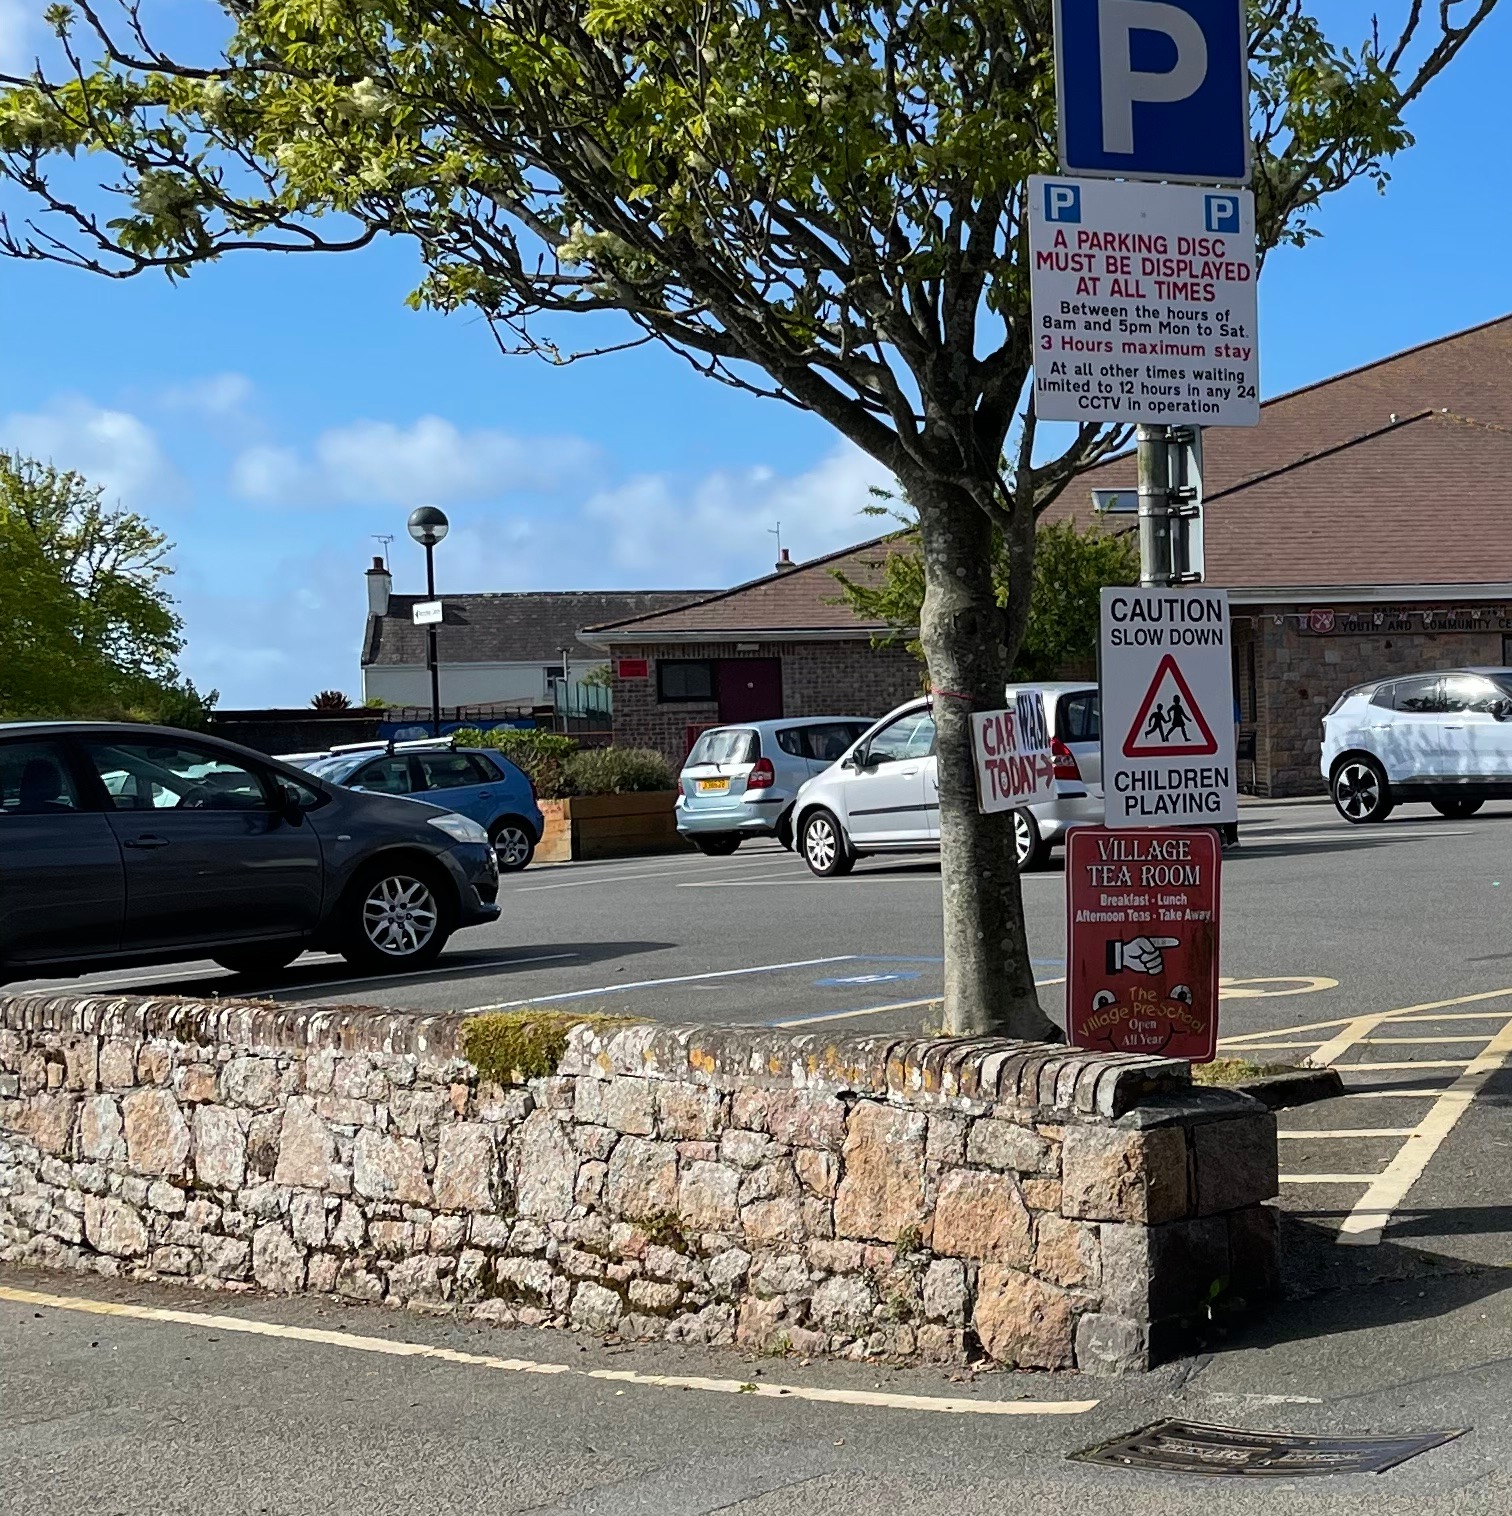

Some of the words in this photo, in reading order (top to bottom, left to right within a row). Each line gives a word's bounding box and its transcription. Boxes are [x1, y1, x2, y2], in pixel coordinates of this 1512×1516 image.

[1098, 0, 1208, 154] P
[1050, 186, 1075, 220] P
[1210, 198, 1234, 230] P
[1054, 229, 1068, 250] A
[1077, 230, 1168, 256] PARKING
[1177, 236, 1226, 258] DISC
[1036, 251, 1096, 272] MUST
[1105, 256, 1132, 276] BE
[1142, 257, 1250, 282] DISPLAYED
[1076, 276, 1100, 296] AT
[1110, 278, 1146, 298] ALL
[1154, 280, 1216, 302] TIMES
[1060, 301, 1128, 318] Between
[1135, 305, 1160, 319] the
[1167, 306, 1208, 322] hours
[1216, 309, 1230, 322] of
[1042, 316, 1076, 330] 8am
[1084, 318, 1112, 332] and
[1119, 320, 1152, 336] 5pm
[1159, 322, 1190, 336] Mon
[1197, 323, 1213, 337] to
[1040, 334, 1052, 350] 3
[1061, 336, 1113, 354] Hours
[1122, 340, 1206, 358] maximum
[1214, 344, 1252, 361] stay
[1050, 362, 1068, 376] At
[1074, 362, 1094, 377] all
[1100, 364, 1140, 379] other
[1146, 366, 1186, 380] times
[1192, 368, 1244, 384] waiting
[1038, 378, 1090, 393] limited
[1098, 380, 1112, 394] to
[1119, 381, 1134, 395] 12
[1141, 382, 1181, 397] hours
[1188, 384, 1200, 397] in
[1206, 386, 1231, 400] any
[1237, 385, 1256, 398] 24
[1078, 396, 1121, 410] CCTV
[1128, 397, 1142, 411] in
[1148, 399, 1220, 414] operation
[1110, 598, 1222, 622] CAUTION
[1388, 620, 1412, 632] AND
[1422, 617, 1491, 631] COMMUNITY
[1111, 628, 1164, 646] SLOW
[1170, 628, 1223, 646] DOWN
[983, 712, 1016, 756] CAR
[985, 754, 1036, 800] TODAY
[1114, 767, 1228, 792] CHILDREN
[1125, 792, 1220, 816] PLAYING
[1098, 837, 1192, 861] VILLAGE
[1086, 865, 1132, 886] TEA
[1141, 864, 1200, 887] ROOM
[1100, 893, 1150, 906] Breakfast
[1158, 892, 1188, 906] Lunch
[1076, 909, 1125, 922] Afternoon
[1127, 908, 1151, 922] Teas
[1158, 908, 1182, 922] Take
[1184, 908, 1211, 923] Away
[1129, 986, 1157, 1002] The
[1128, 1018, 1156, 1032] Open
[1122, 1034, 1138, 1046] All
[1140, 1033, 1164, 1045] Year
